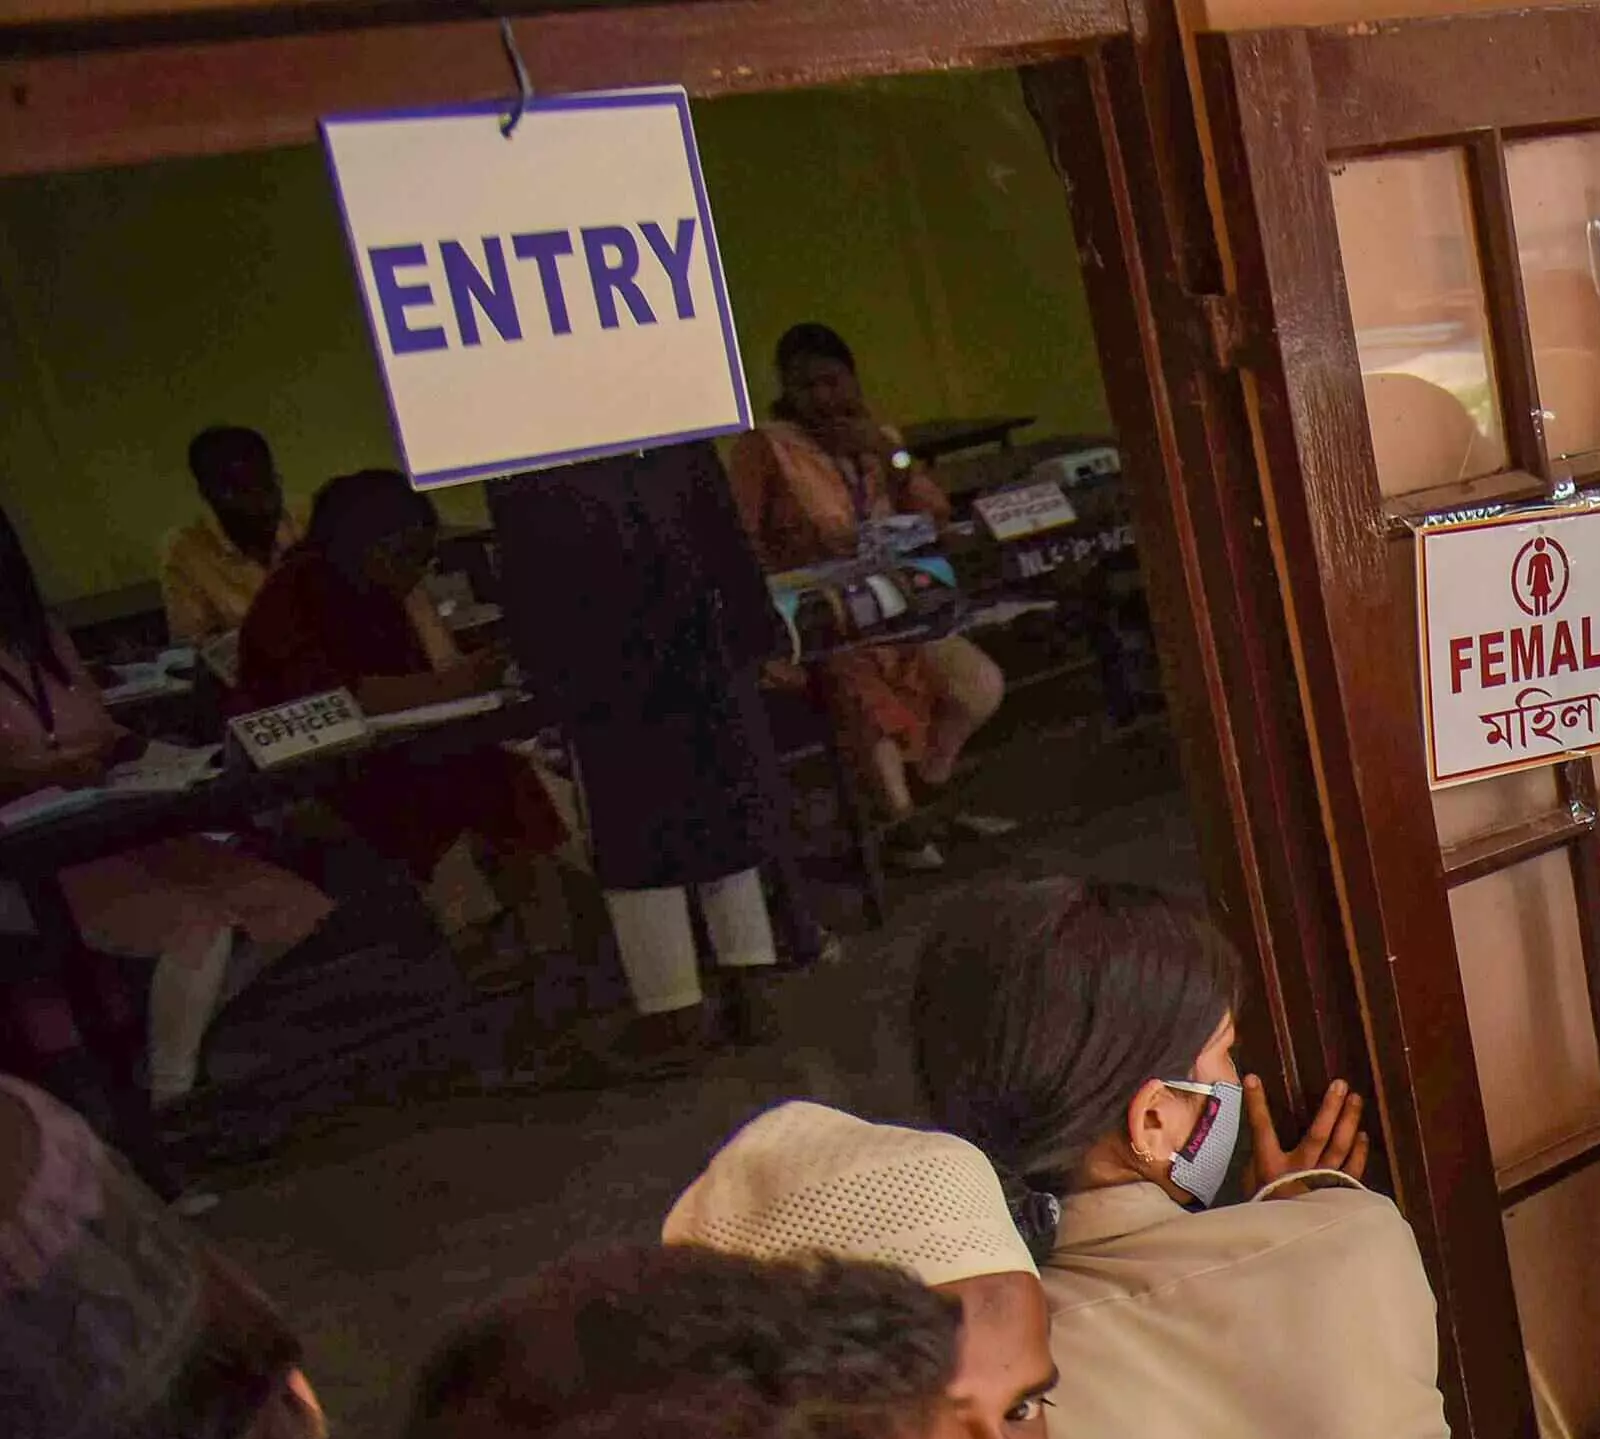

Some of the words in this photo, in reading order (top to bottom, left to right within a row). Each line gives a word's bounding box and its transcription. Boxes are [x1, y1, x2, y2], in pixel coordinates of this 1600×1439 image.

[367, 217, 696, 356] ENTRY
[243, 694, 346, 735] POLLING
[253, 708, 354, 748] OFFICER
